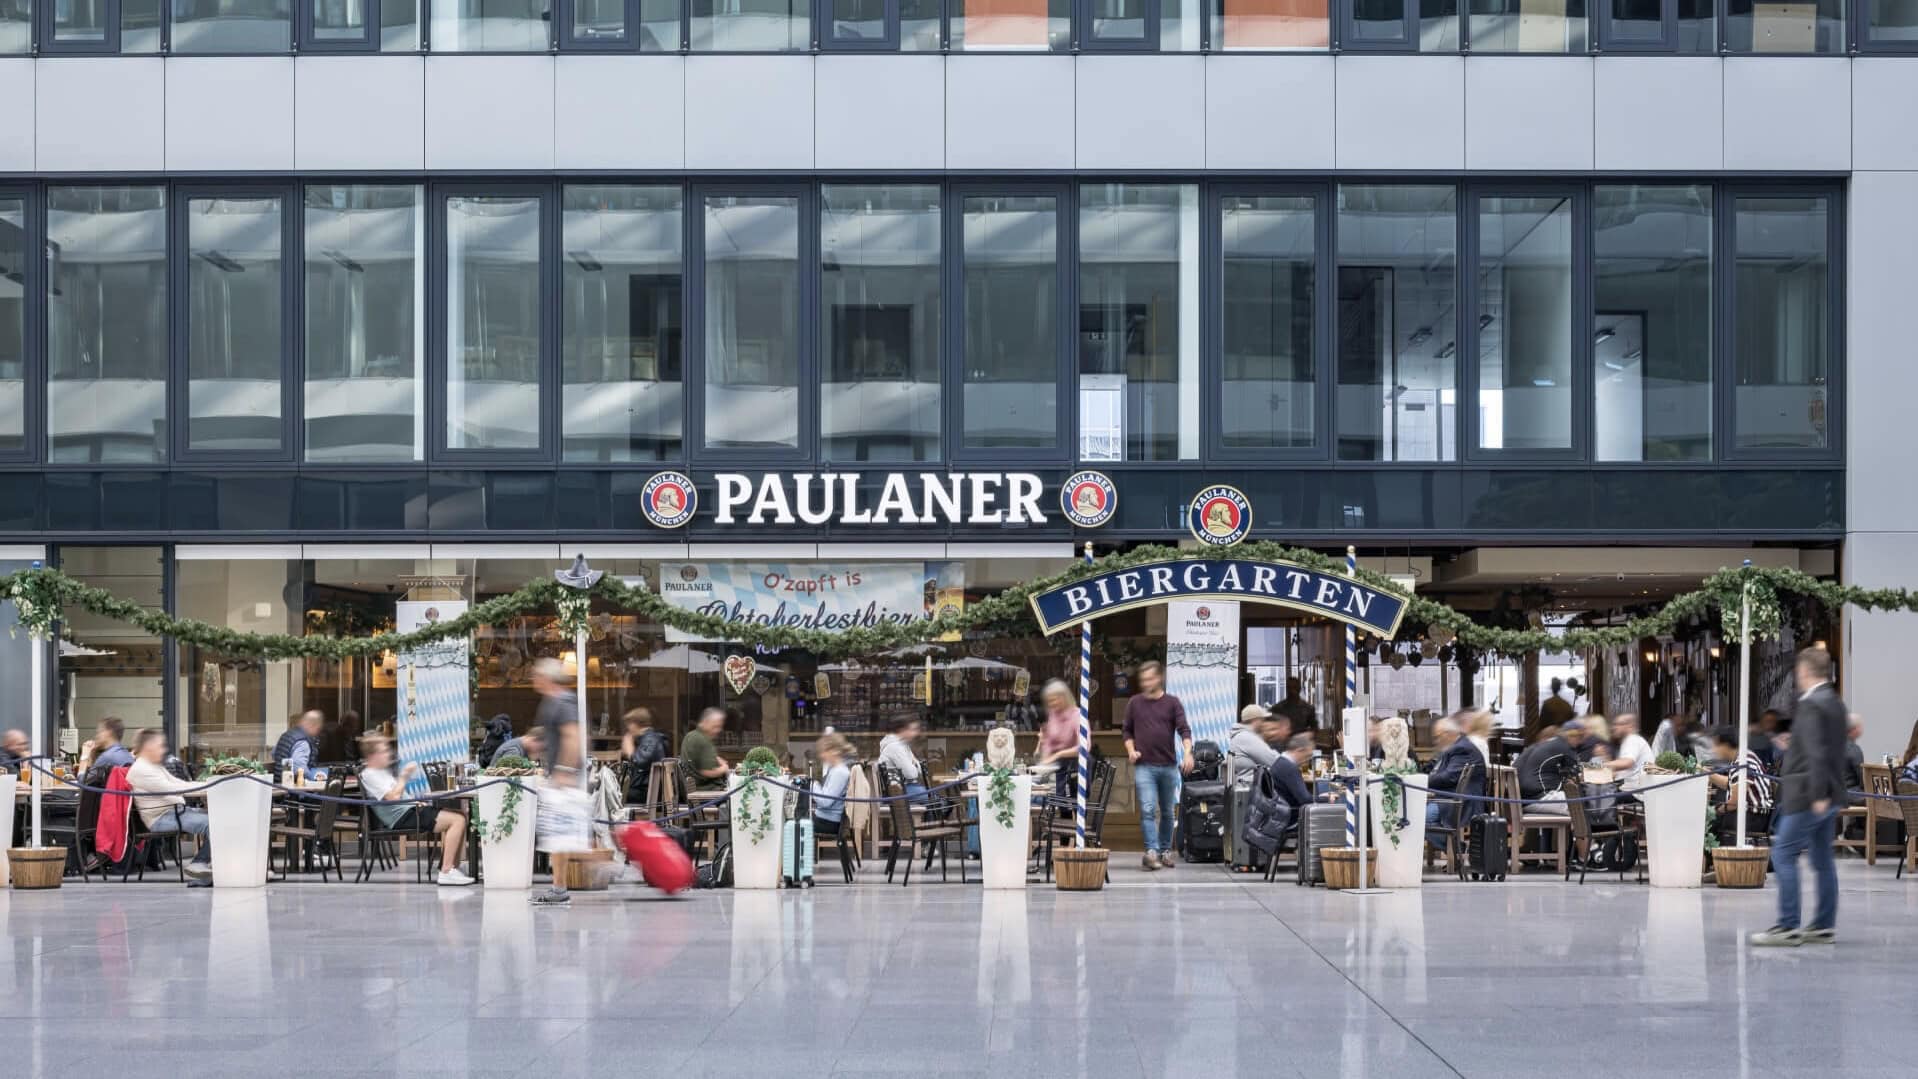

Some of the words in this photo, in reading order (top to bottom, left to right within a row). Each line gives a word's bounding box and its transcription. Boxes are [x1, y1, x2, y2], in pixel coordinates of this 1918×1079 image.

[646, 474, 692, 494] PAULANER
[1065, 474, 1112, 494] PAULANER
[713, 472, 1048, 525] PAULANER
[1194, 488, 1247, 510] PAULANER
[664, 582, 713, 592] PAULANER
[763, 572, 837, 597] O'zapft
[845, 570, 861, 587] is
[1062, 563, 1376, 618] BIERGARTEN
[1186, 619, 1220, 628] PAULANER
